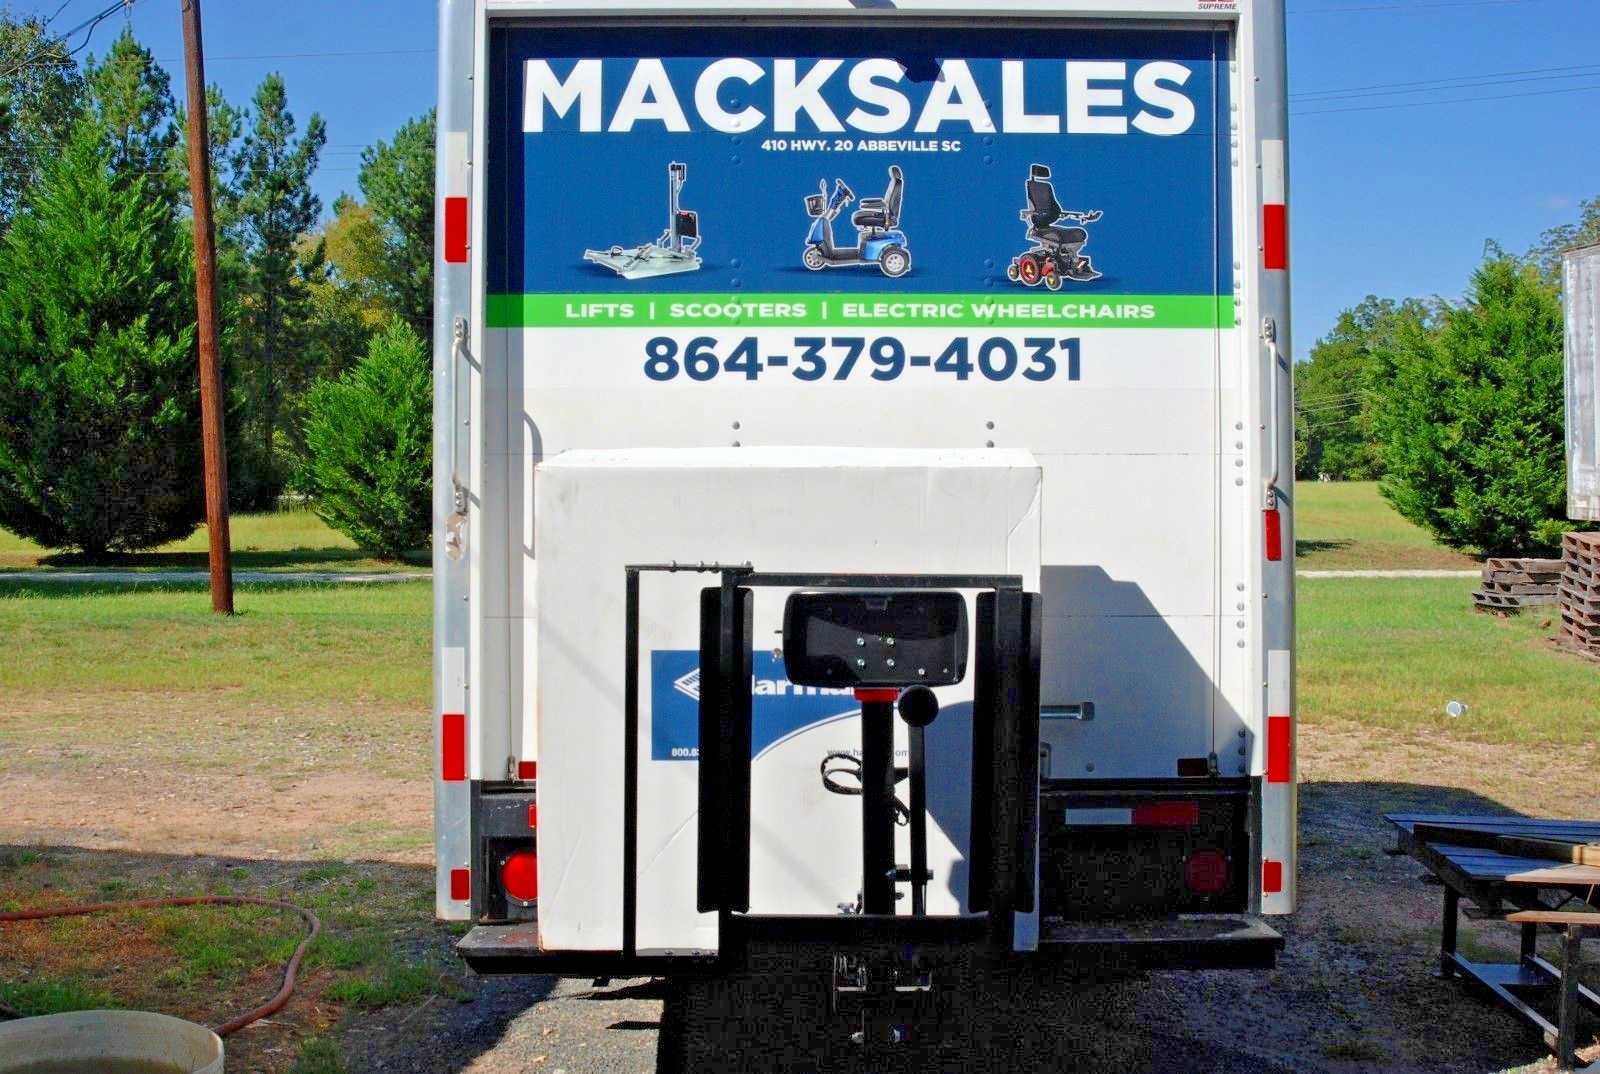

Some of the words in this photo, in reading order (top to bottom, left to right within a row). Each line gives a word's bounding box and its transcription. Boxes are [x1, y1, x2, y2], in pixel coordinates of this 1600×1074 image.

[523, 57, 1196, 136] MACKSALES
[761, 139, 788, 152] 410
[790, 139, 831, 152] HWY.
[834, 139, 854, 152] 20
[856, 139, 939, 152] ABBEVILLE
[941, 139, 961, 152] SC
[565, 303, 635, 319] LIFTS
[669, 302, 808, 320] SCOOTERS
[842, 302, 964, 319] ELECTRIC
[971, 302, 1156, 320] WHEELCHAIRS
[643, 336, 1081, 382] 864-379-4031
